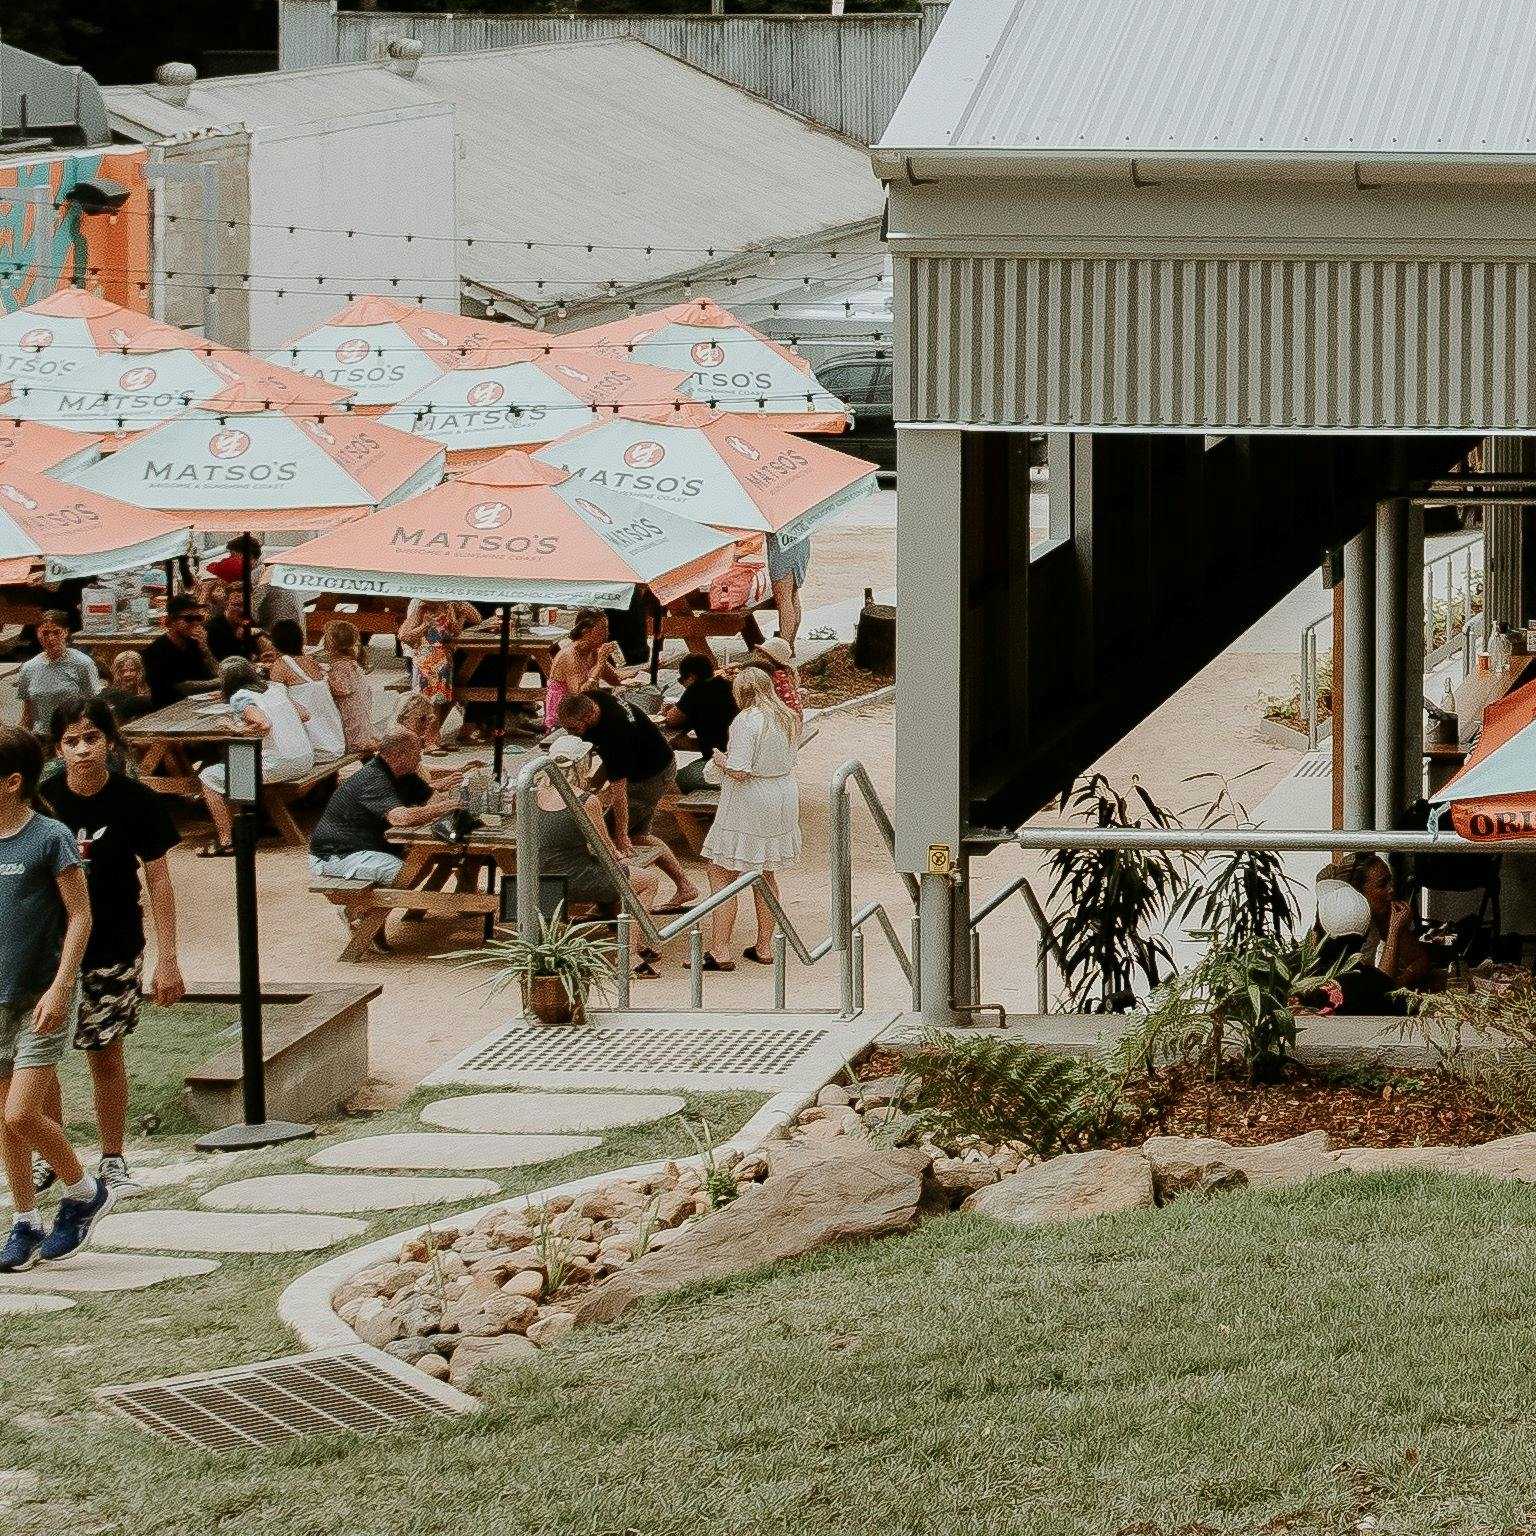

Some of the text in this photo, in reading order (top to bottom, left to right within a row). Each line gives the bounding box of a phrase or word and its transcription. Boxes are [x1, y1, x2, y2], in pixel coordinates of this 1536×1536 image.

[299, 365, 405, 383] ATSO'S
[693, 371, 772, 390] TSO'S
[142, 460, 298, 481] MATSO'S
[388, 526, 560, 555] MATSO'S
